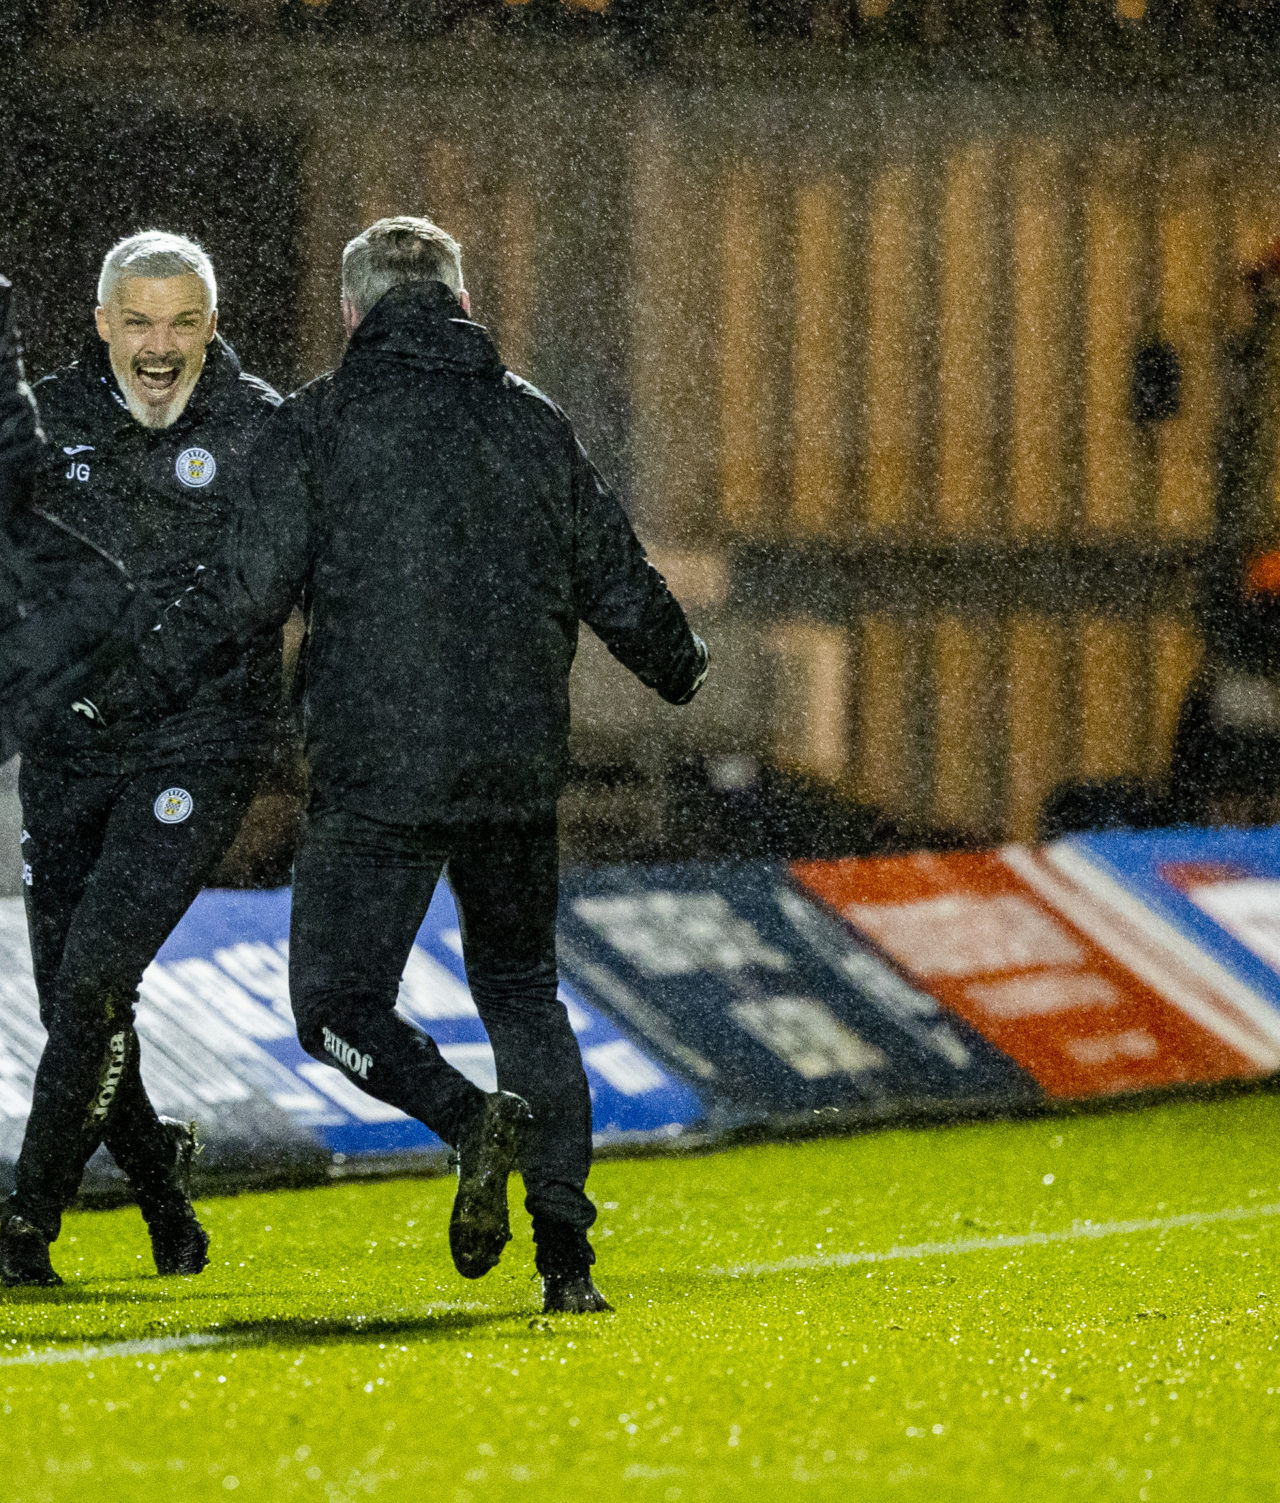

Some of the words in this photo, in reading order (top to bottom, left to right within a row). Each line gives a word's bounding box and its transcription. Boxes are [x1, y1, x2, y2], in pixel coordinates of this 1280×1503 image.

[66, 463, 90, 482] JG
[93, 1032, 126, 1122] Joma
[322, 1026, 373, 1080] Joma
